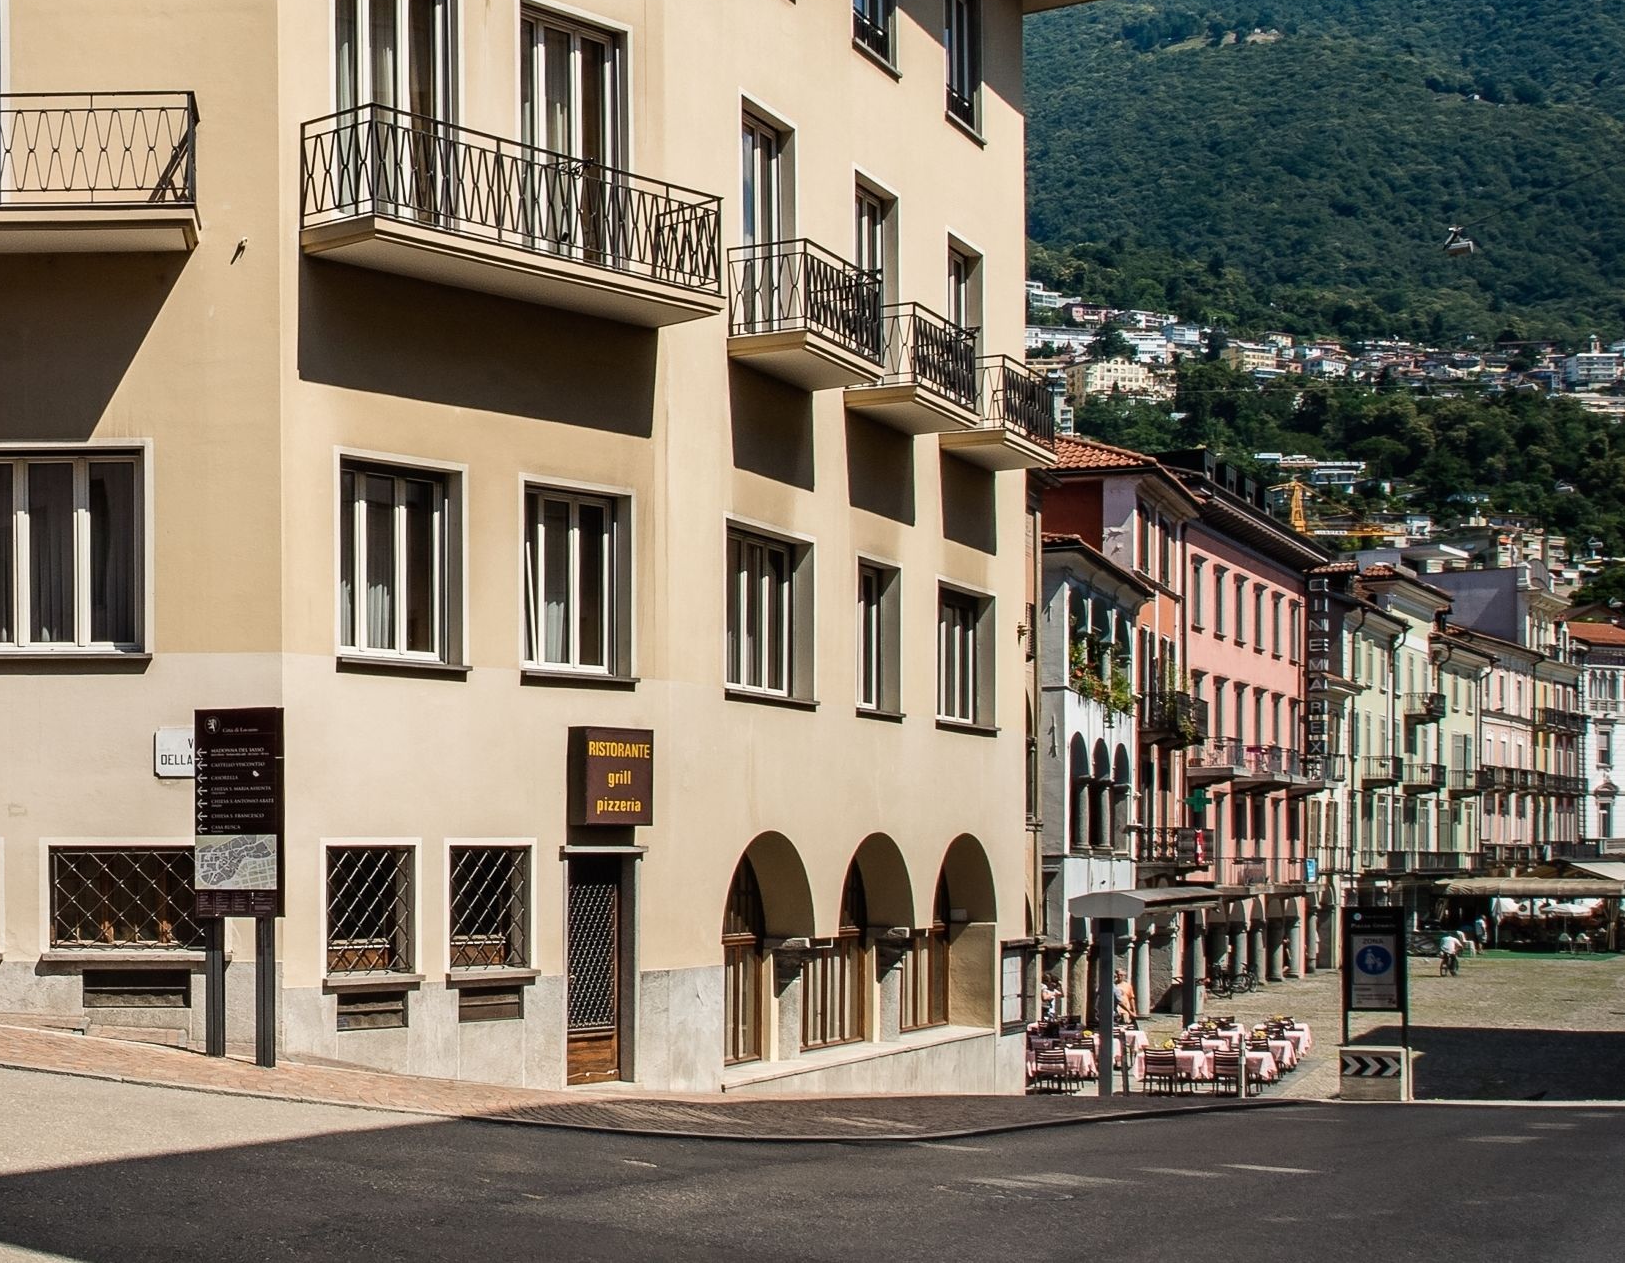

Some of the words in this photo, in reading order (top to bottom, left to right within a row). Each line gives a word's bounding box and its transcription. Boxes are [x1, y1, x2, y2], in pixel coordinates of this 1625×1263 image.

[1309, 578, 1325, 691] CINEMA
[1310, 701, 1323, 754] REX
[588, 741, 650, 758] RISTORANTE
[160, 754, 193, 765] DELLA
[608, 770, 631, 788] grill
[596, 797, 642, 815] pizzeria
